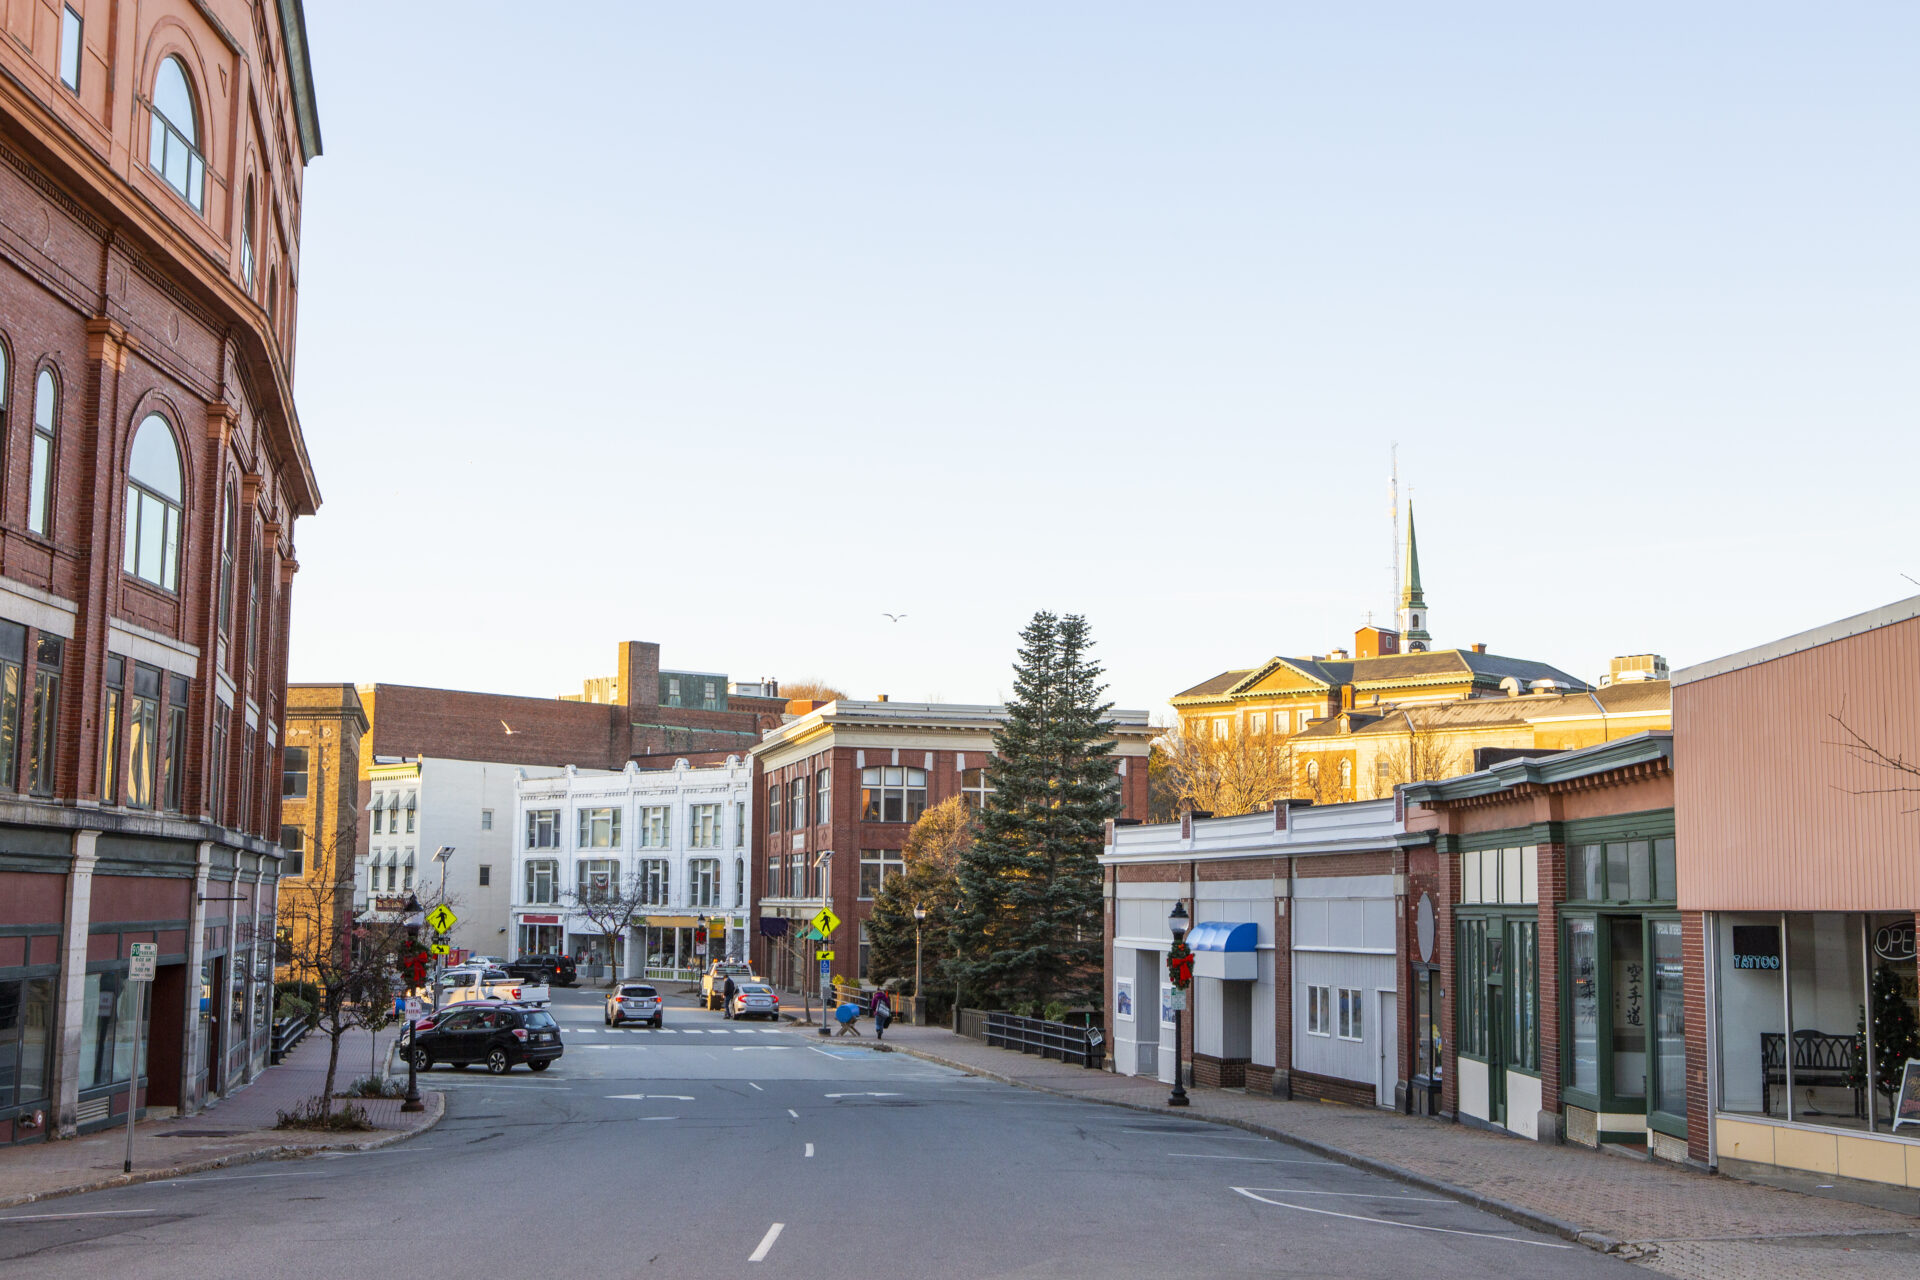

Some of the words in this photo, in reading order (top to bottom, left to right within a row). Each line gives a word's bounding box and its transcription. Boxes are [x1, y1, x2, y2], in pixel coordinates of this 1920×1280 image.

[1733, 954, 1779, 969] TATTOO
[1626, 963, 1644, 1026] 空手道
